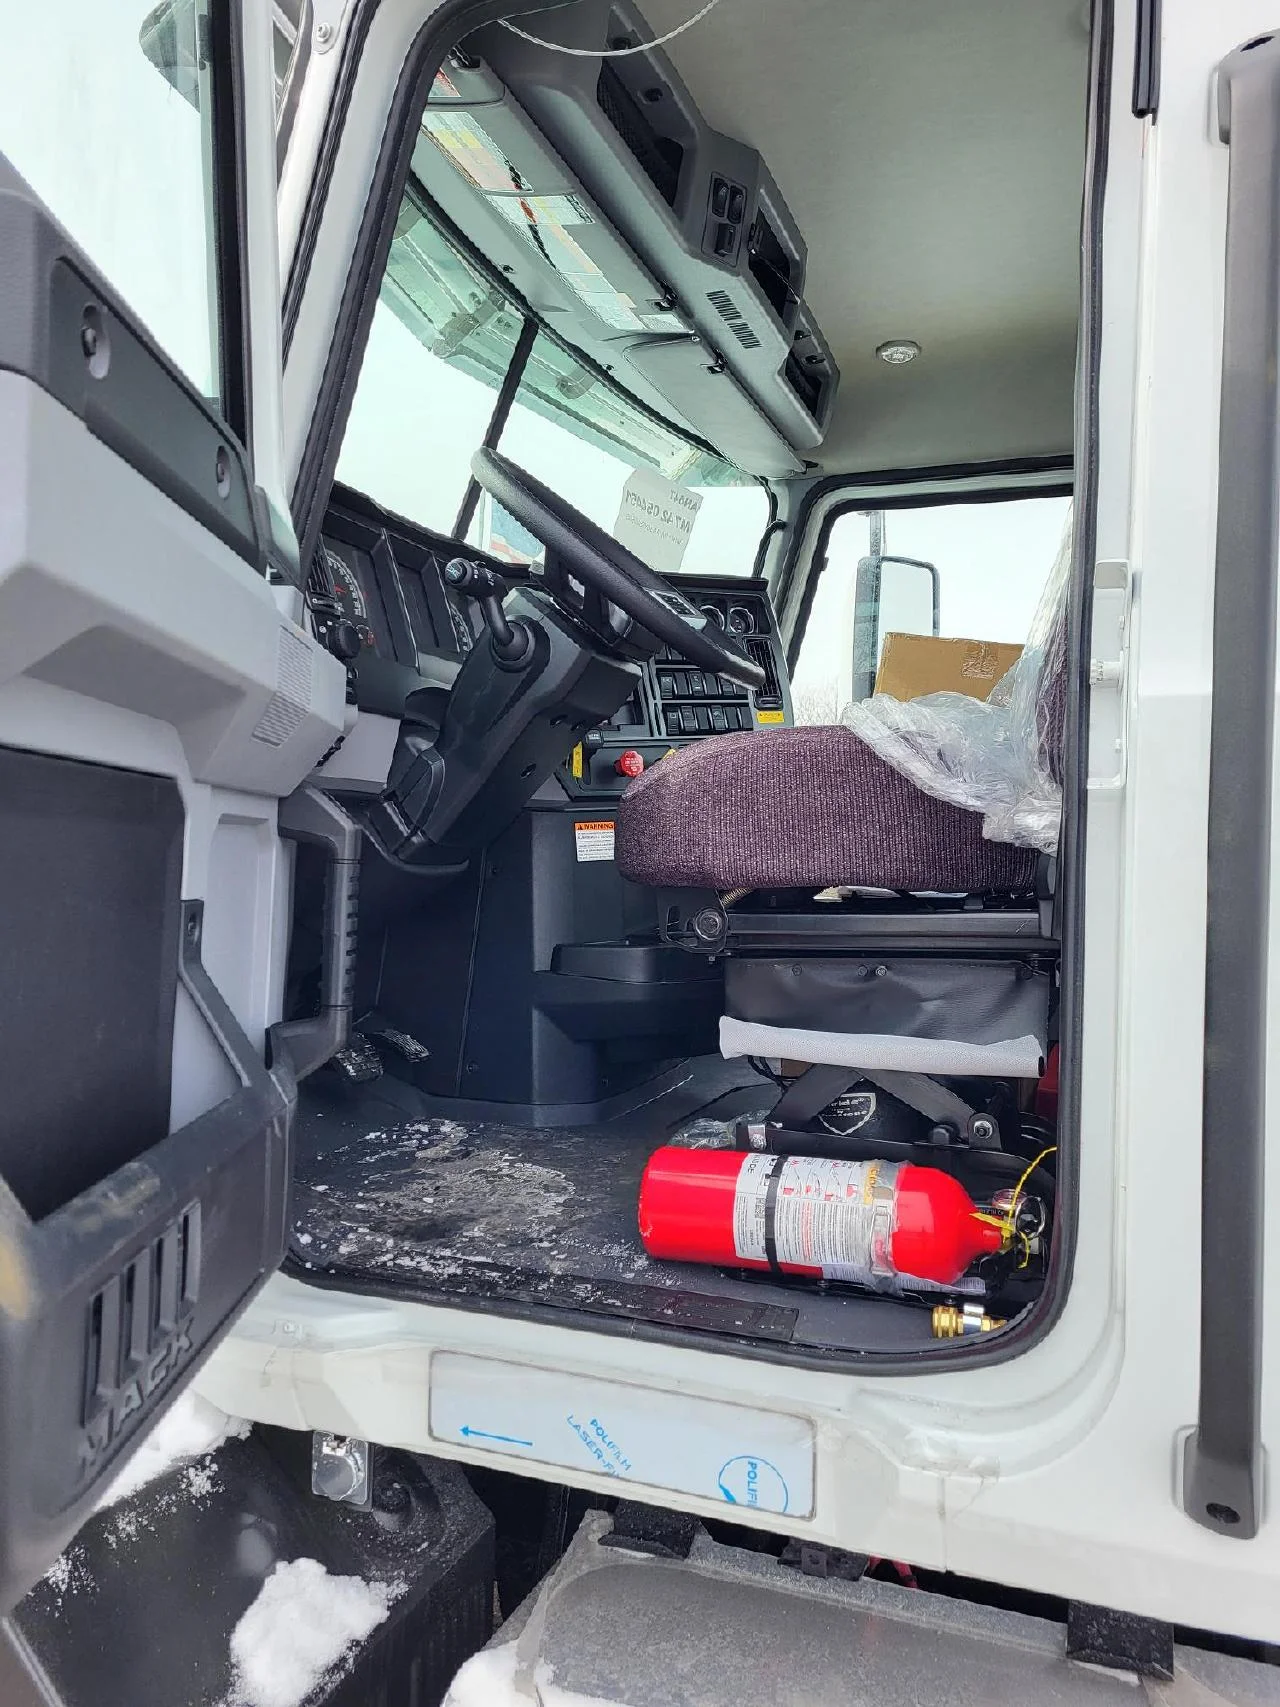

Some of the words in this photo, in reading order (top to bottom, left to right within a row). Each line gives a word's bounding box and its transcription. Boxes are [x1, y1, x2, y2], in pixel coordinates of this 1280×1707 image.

[584, 823, 614, 831] WARNING
[78, 1316, 195, 1482] MACK
[590, 1418, 632, 1471] POLIFILM
